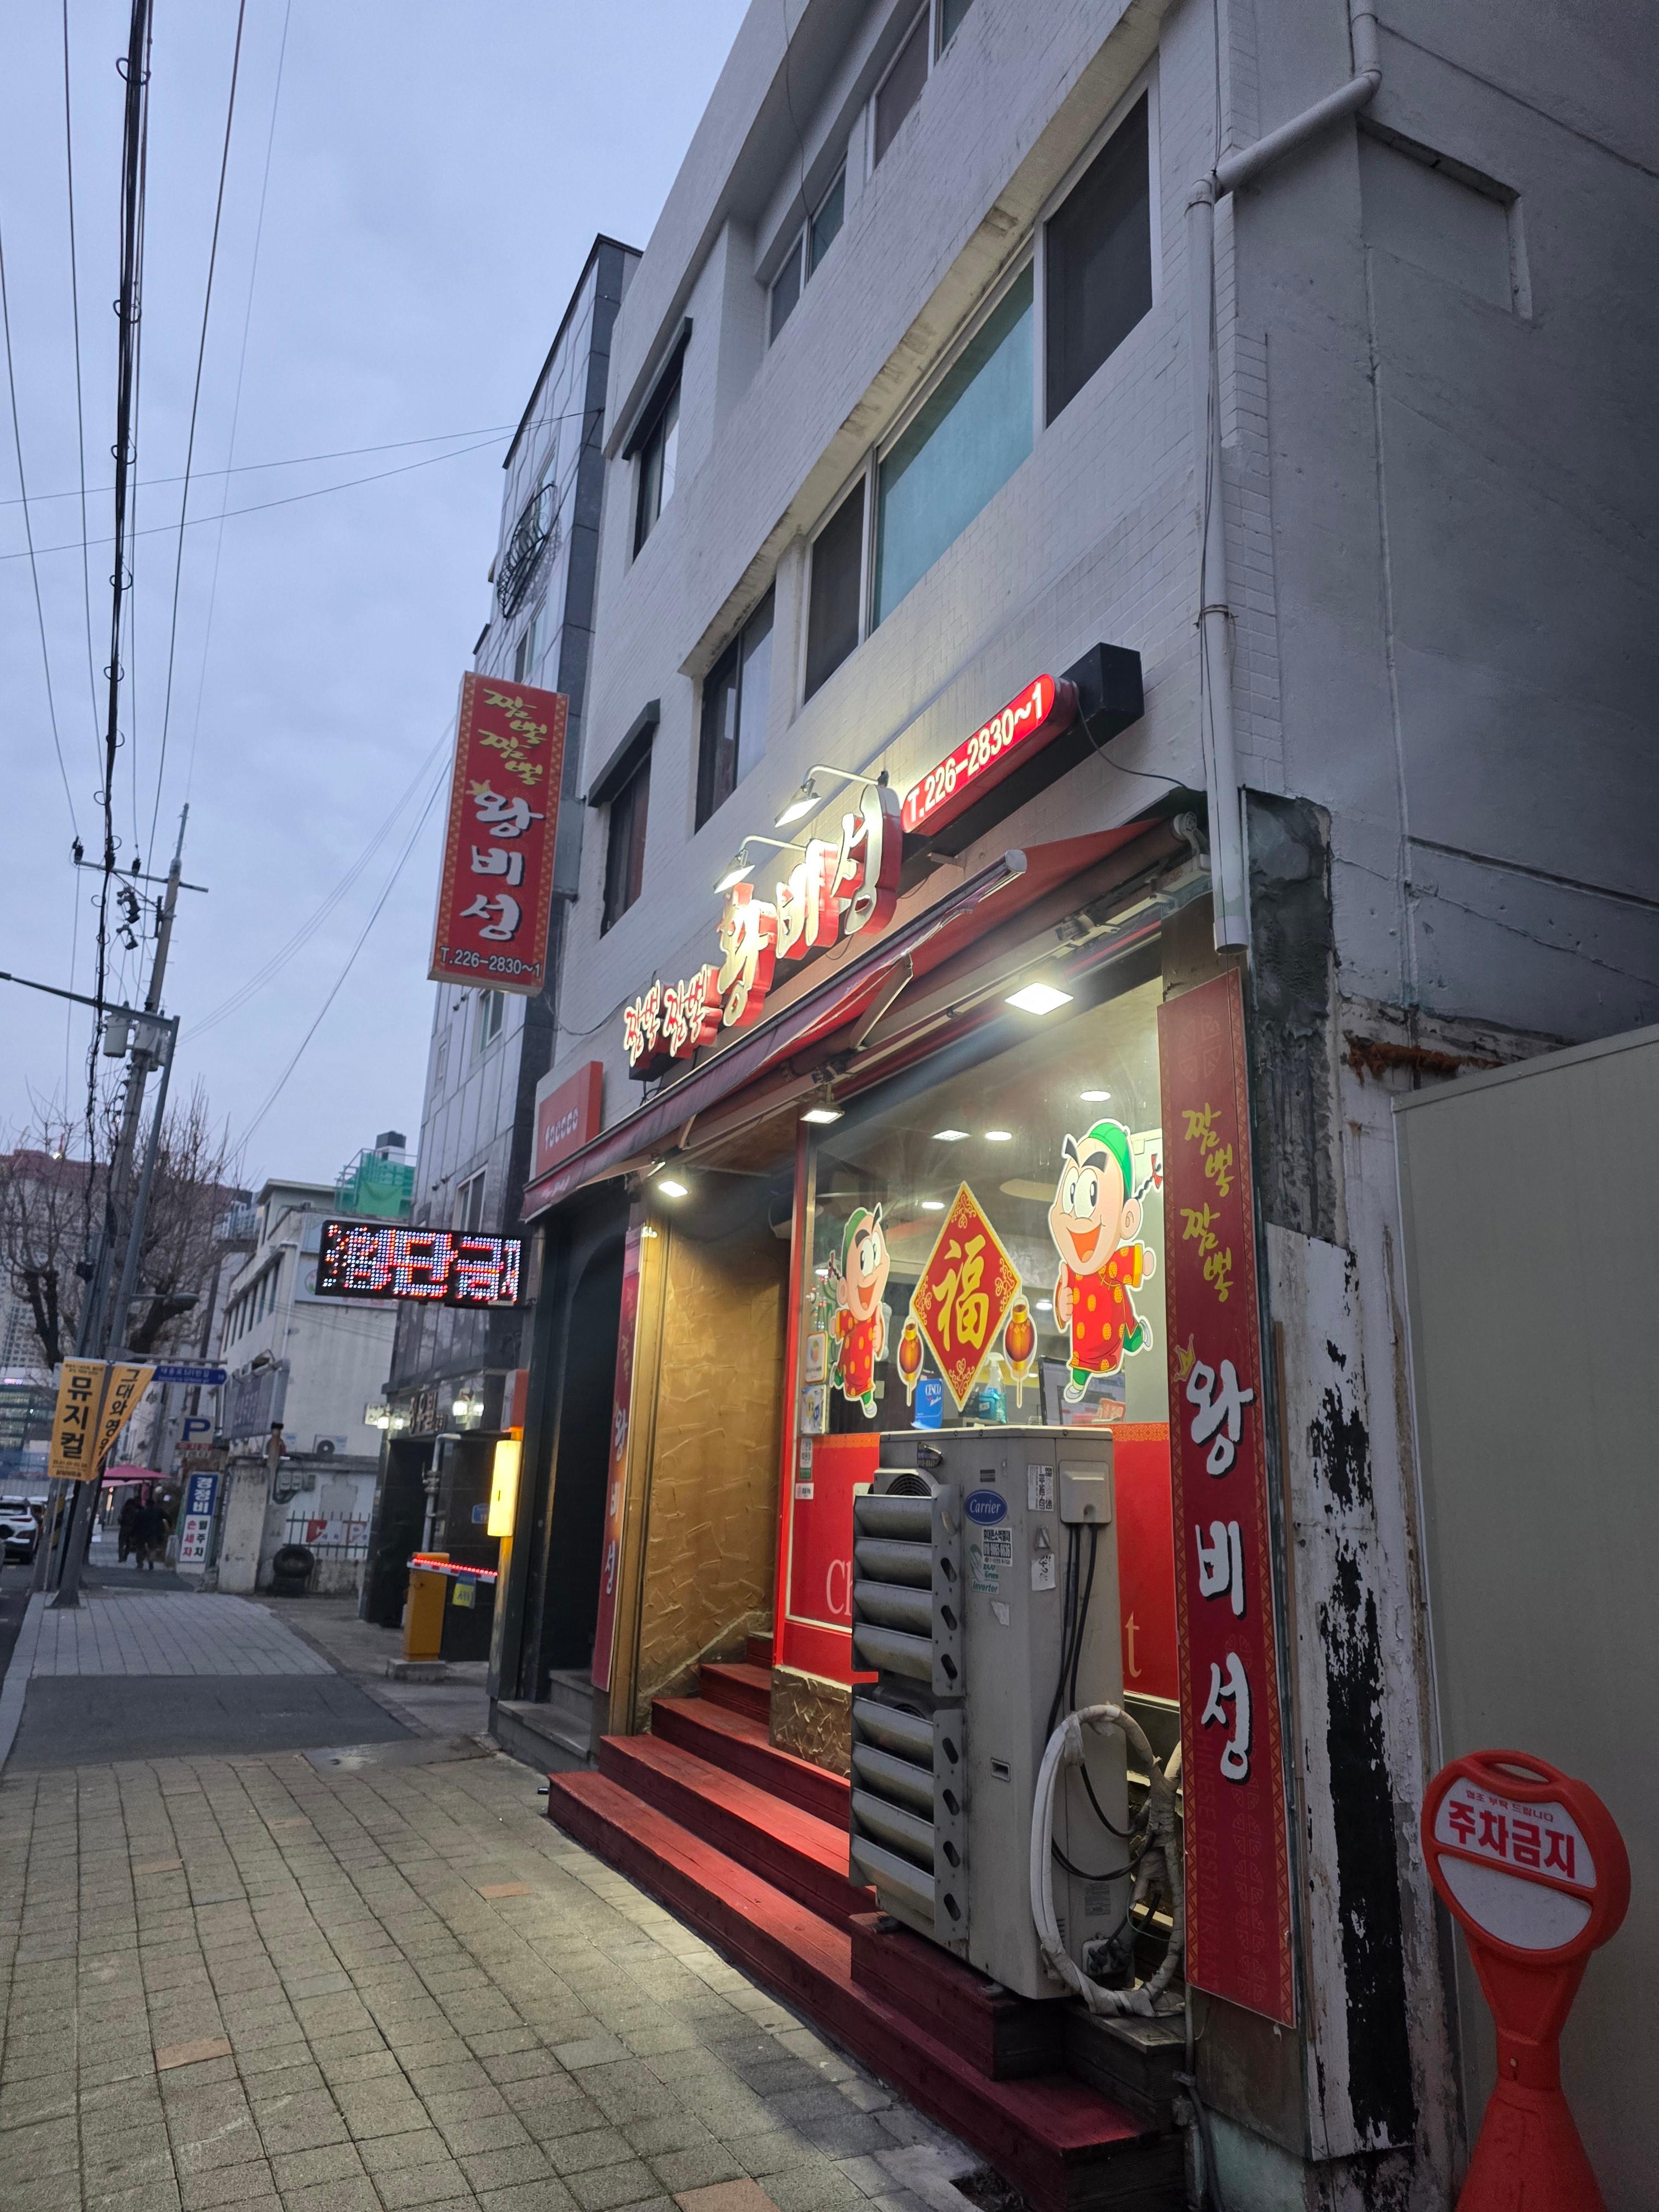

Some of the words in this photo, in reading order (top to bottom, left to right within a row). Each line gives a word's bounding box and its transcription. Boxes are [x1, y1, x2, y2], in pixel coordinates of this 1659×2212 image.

[907, 682, 1042, 822] T.226-2830~1
[460, 791, 545, 941] 왕비성
[718, 785, 884, 1027] 왕비성
[440, 946, 541, 978] T.226-2830~1
[1182, 1103, 1234, 1197] 짬뽕
[931, 1234, 987, 1350] 福
[1180, 1202, 1234, 1303] 짬뽕
[61, 1376, 92, 1459] 뮤지컬
[109, 1368, 140, 1416] 그대와
[181, 1417, 211, 1441] P
[192, 1477, 213, 1513] 경정비
[969, 1499, 1001, 1514] Carrier
[1185, 1359, 1254, 1782] 왕비성
[1448, 1799, 1575, 1880] 주차금지
[1465, 1790, 1485, 1802] 협조
[1489, 1796, 1509, 1810] 부탁
[1512, 1802, 1554, 1823] 드립니다
